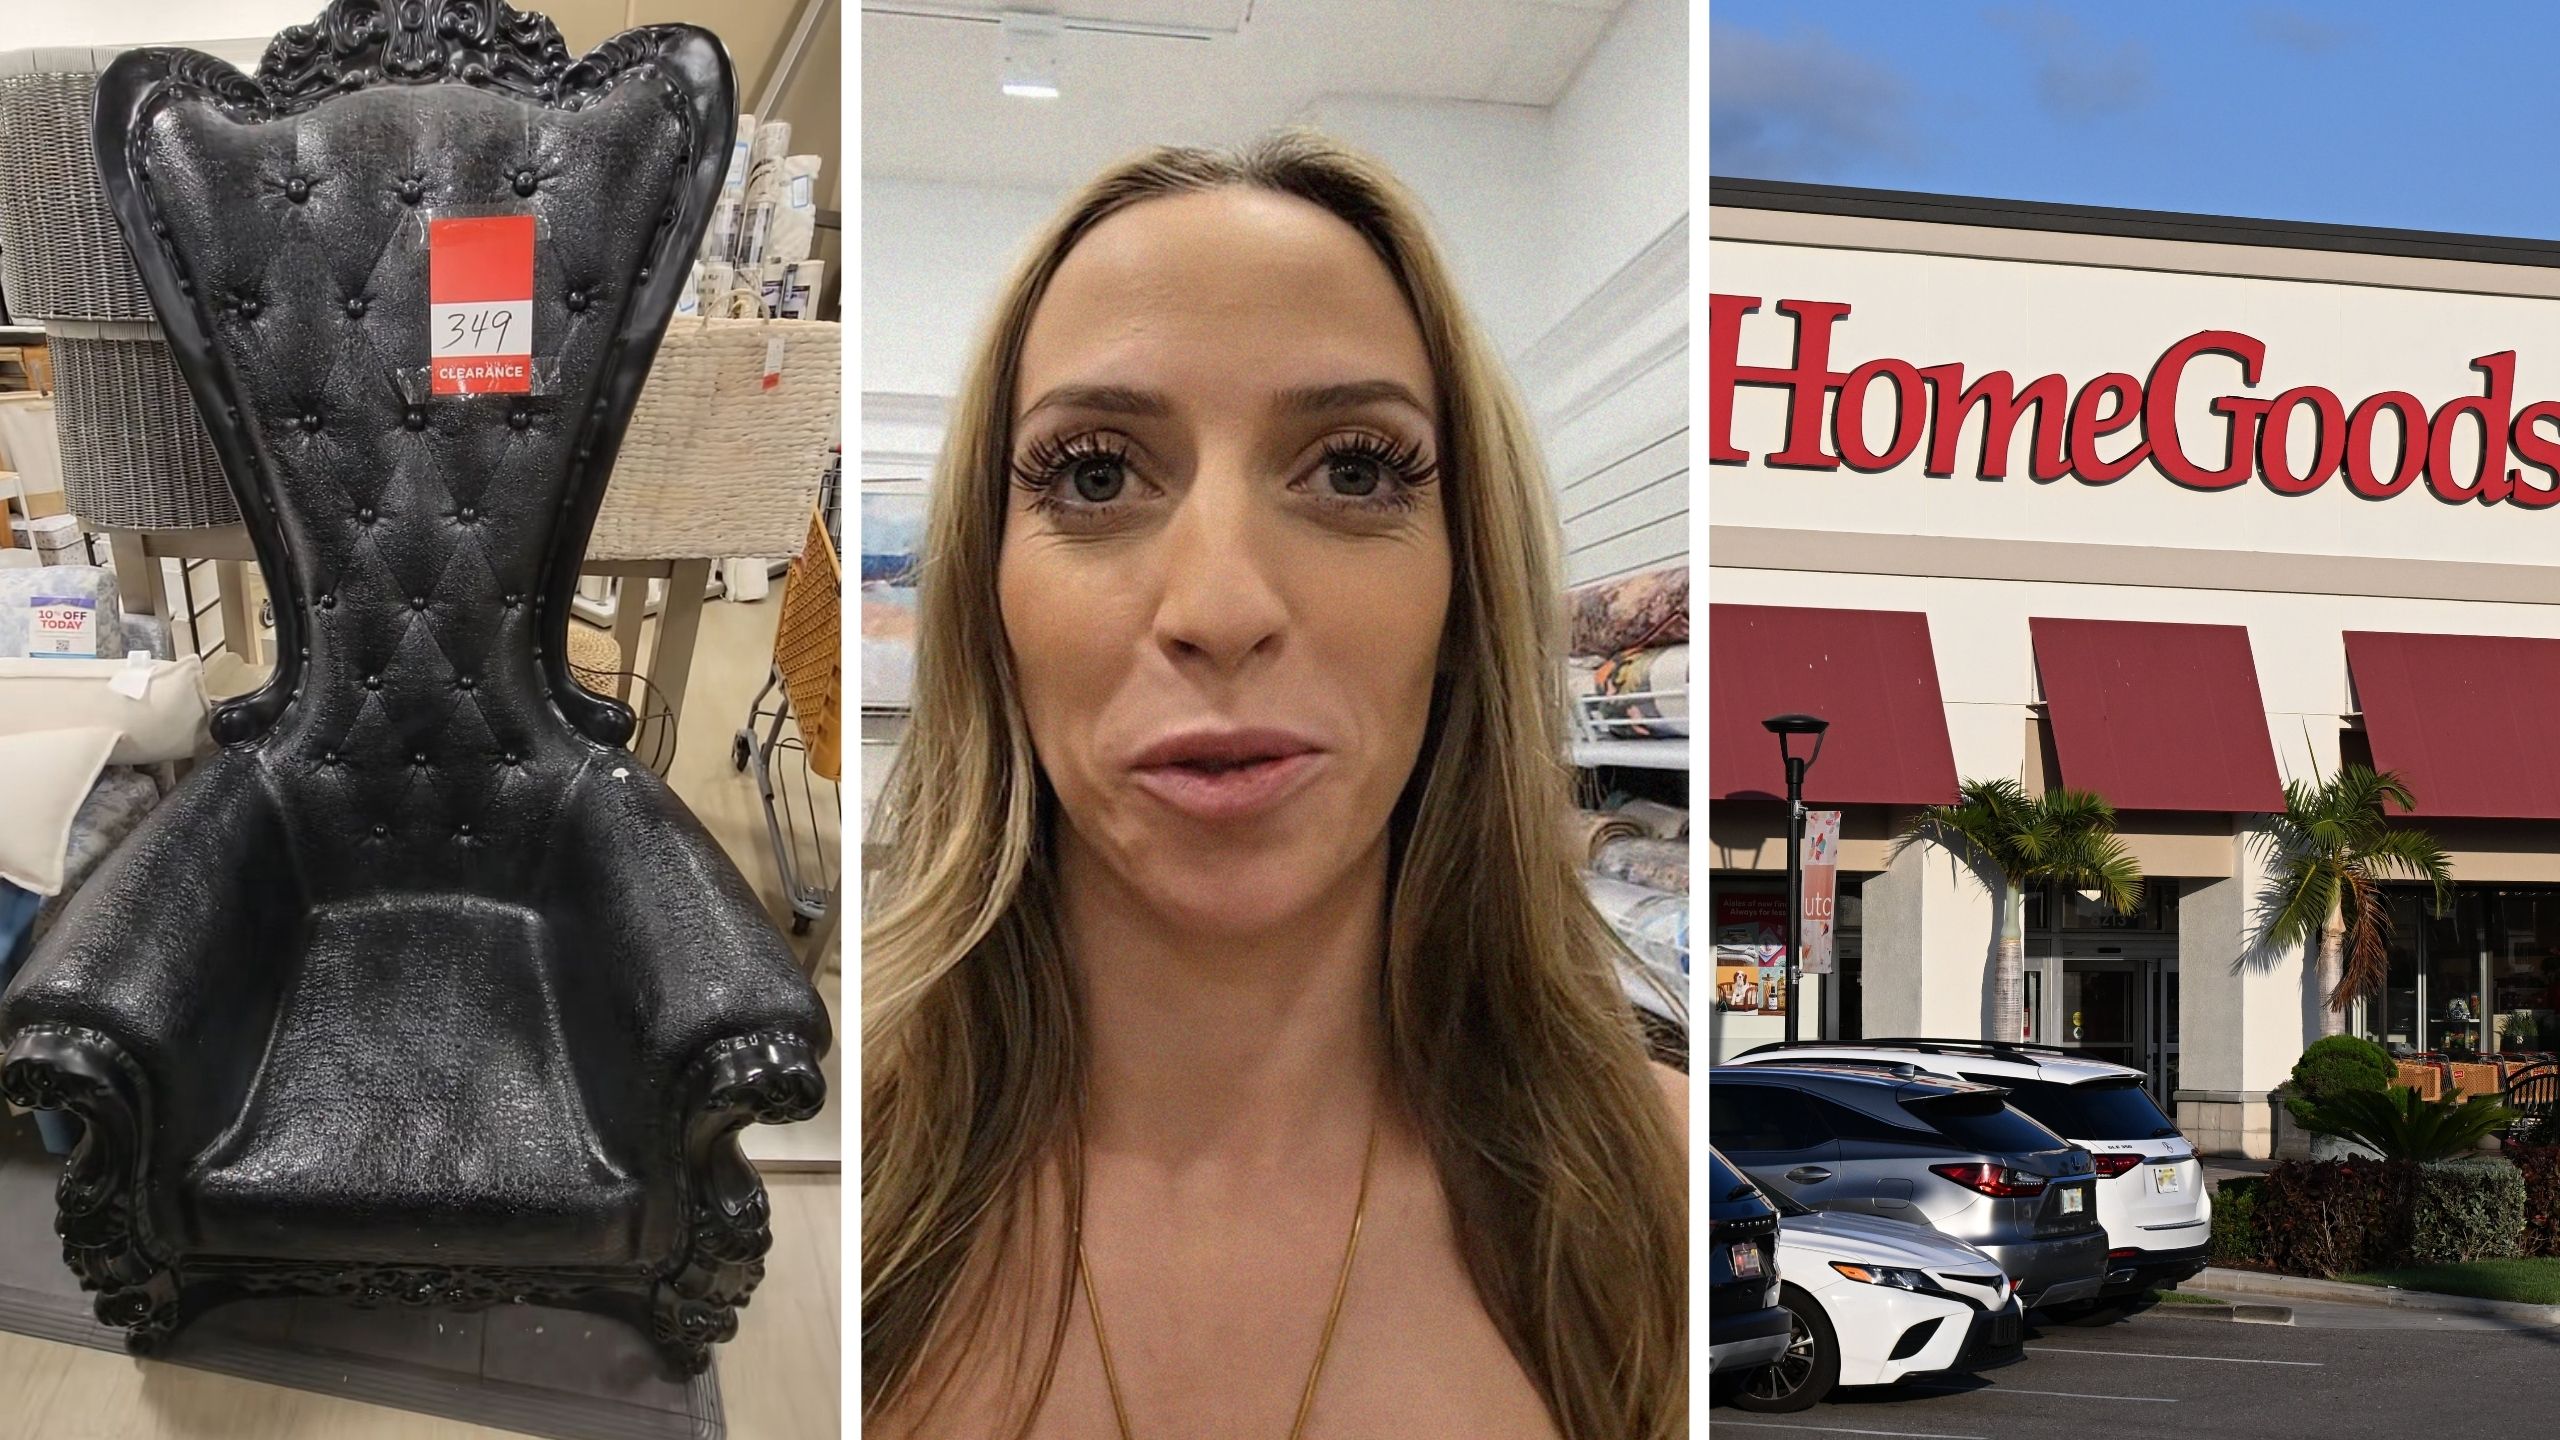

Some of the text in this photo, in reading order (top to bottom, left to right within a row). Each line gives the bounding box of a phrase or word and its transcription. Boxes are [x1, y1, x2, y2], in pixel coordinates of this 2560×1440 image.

[441, 310, 513, 353] 349
[439, 365, 524, 380] CLEARANCE
[1709, 293, 2560, 508] HomeGoods
[63, 610, 87, 620] OFF
[40, 619, 82, 630] TODAY
[1805, 891, 1831, 916] utc
[1730, 908, 1757, 917] Always
[1759, 908, 1770, 916] for
